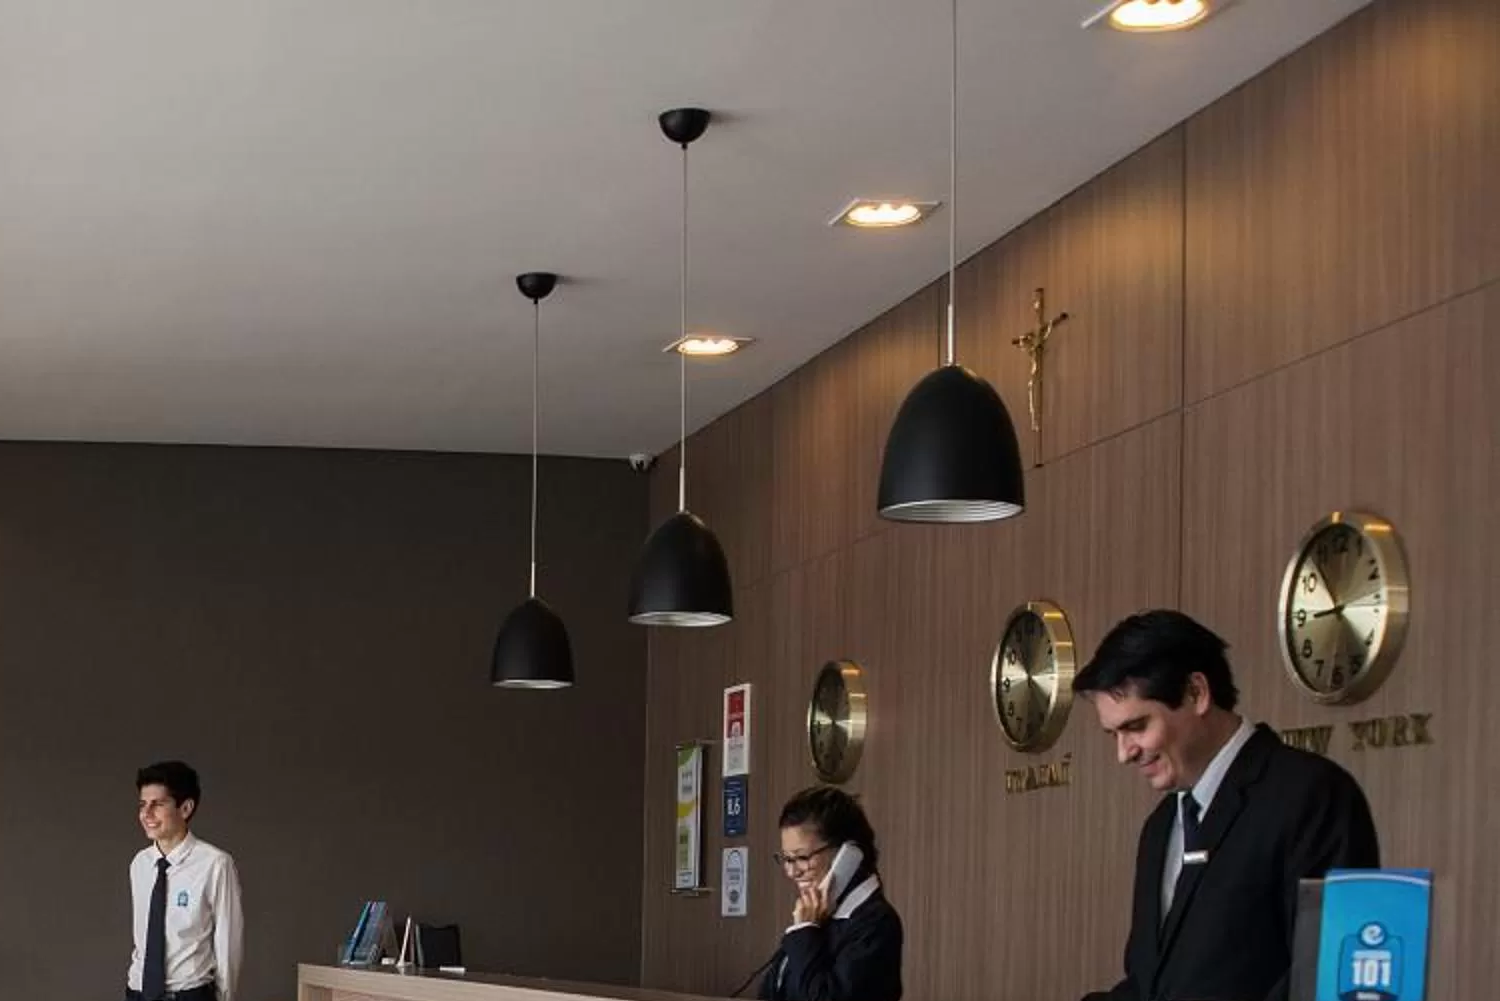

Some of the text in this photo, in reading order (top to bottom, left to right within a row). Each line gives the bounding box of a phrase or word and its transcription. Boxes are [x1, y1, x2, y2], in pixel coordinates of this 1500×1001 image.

[1302, 572, 1317, 594] 10
[1297, 608, 1307, 628] 9
[1303, 639, 1313, 659] 8
[1314, 659, 1325, 677] 7
[1348, 713, 1435, 752] YORK
[1352, 959, 1391, 987] 101
